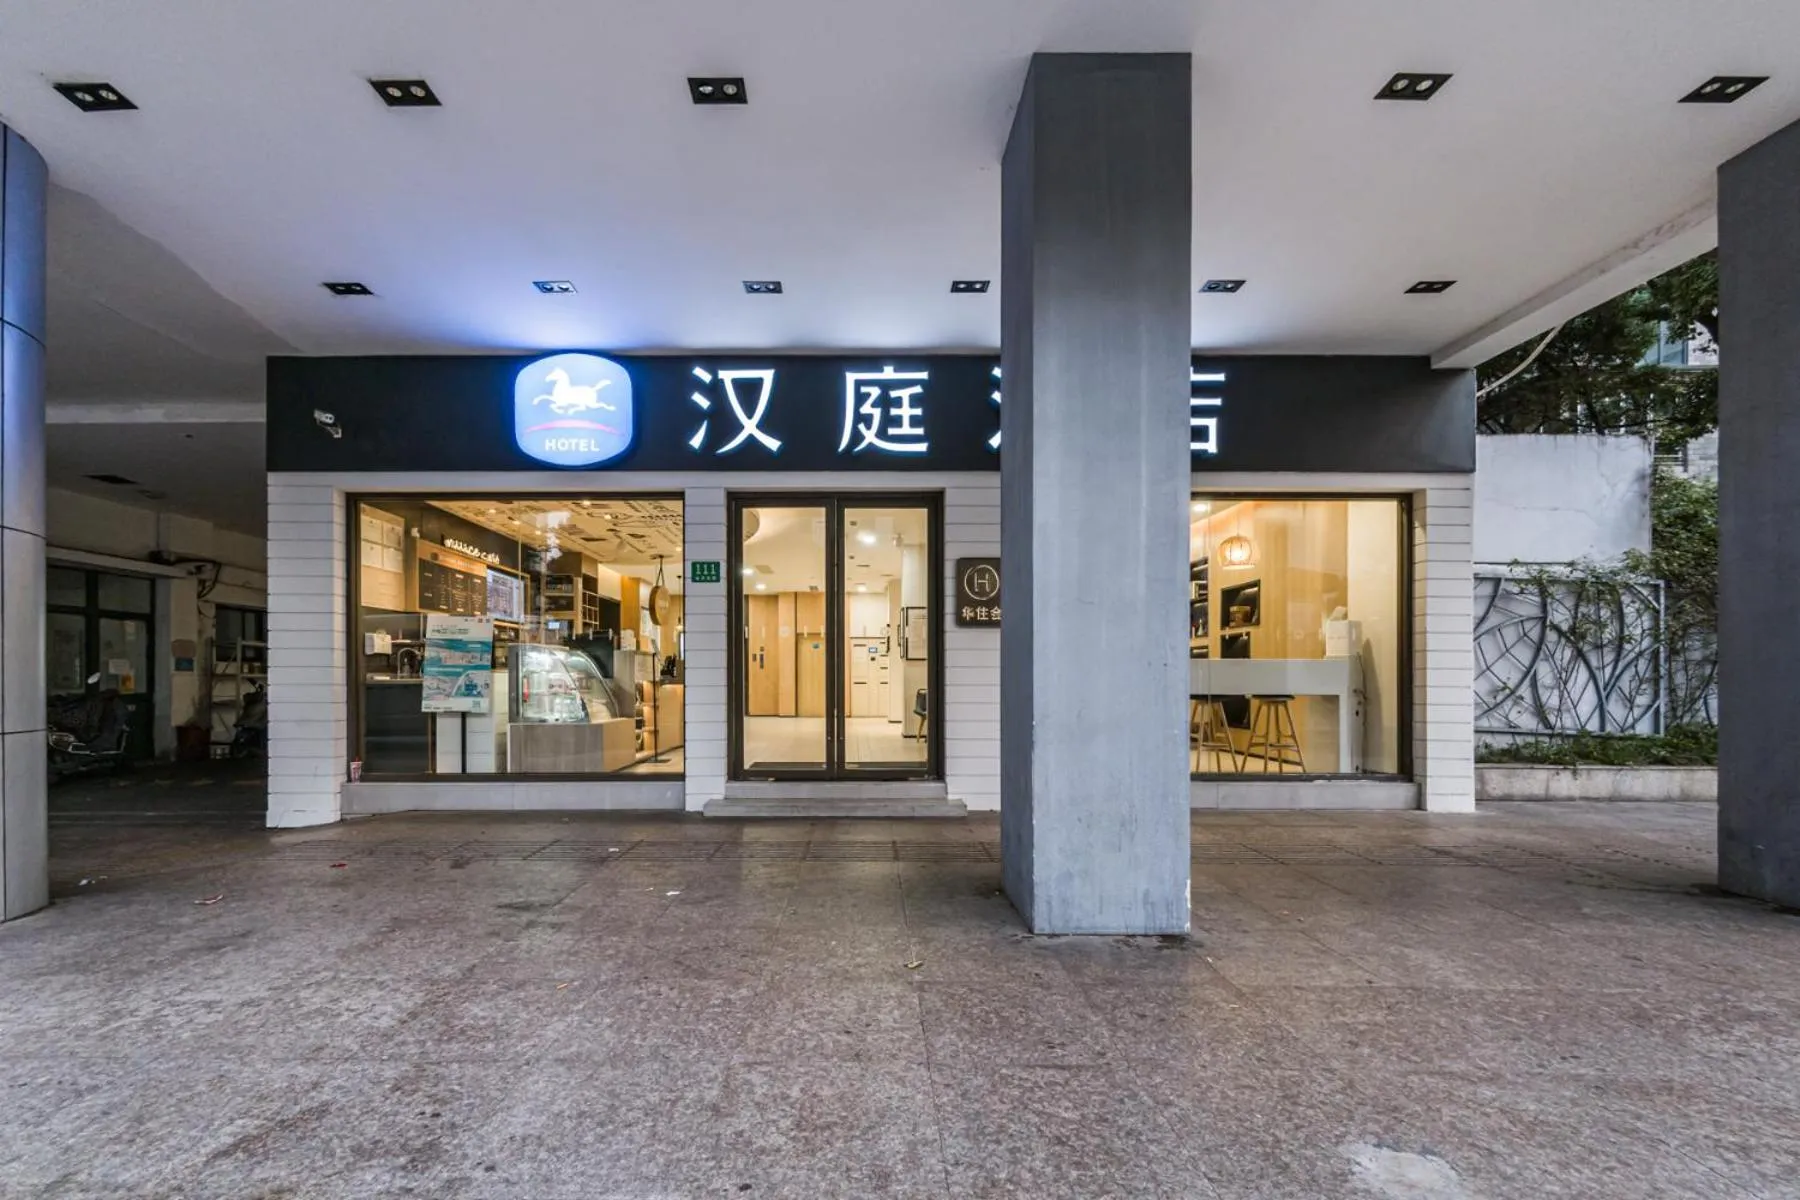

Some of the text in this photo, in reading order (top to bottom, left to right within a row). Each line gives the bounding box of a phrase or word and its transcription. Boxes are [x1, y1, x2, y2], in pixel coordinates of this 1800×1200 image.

[545, 438, 600, 452] HOTEL
[696, 563, 716, 575] 111
[974, 571, 990, 592] H
